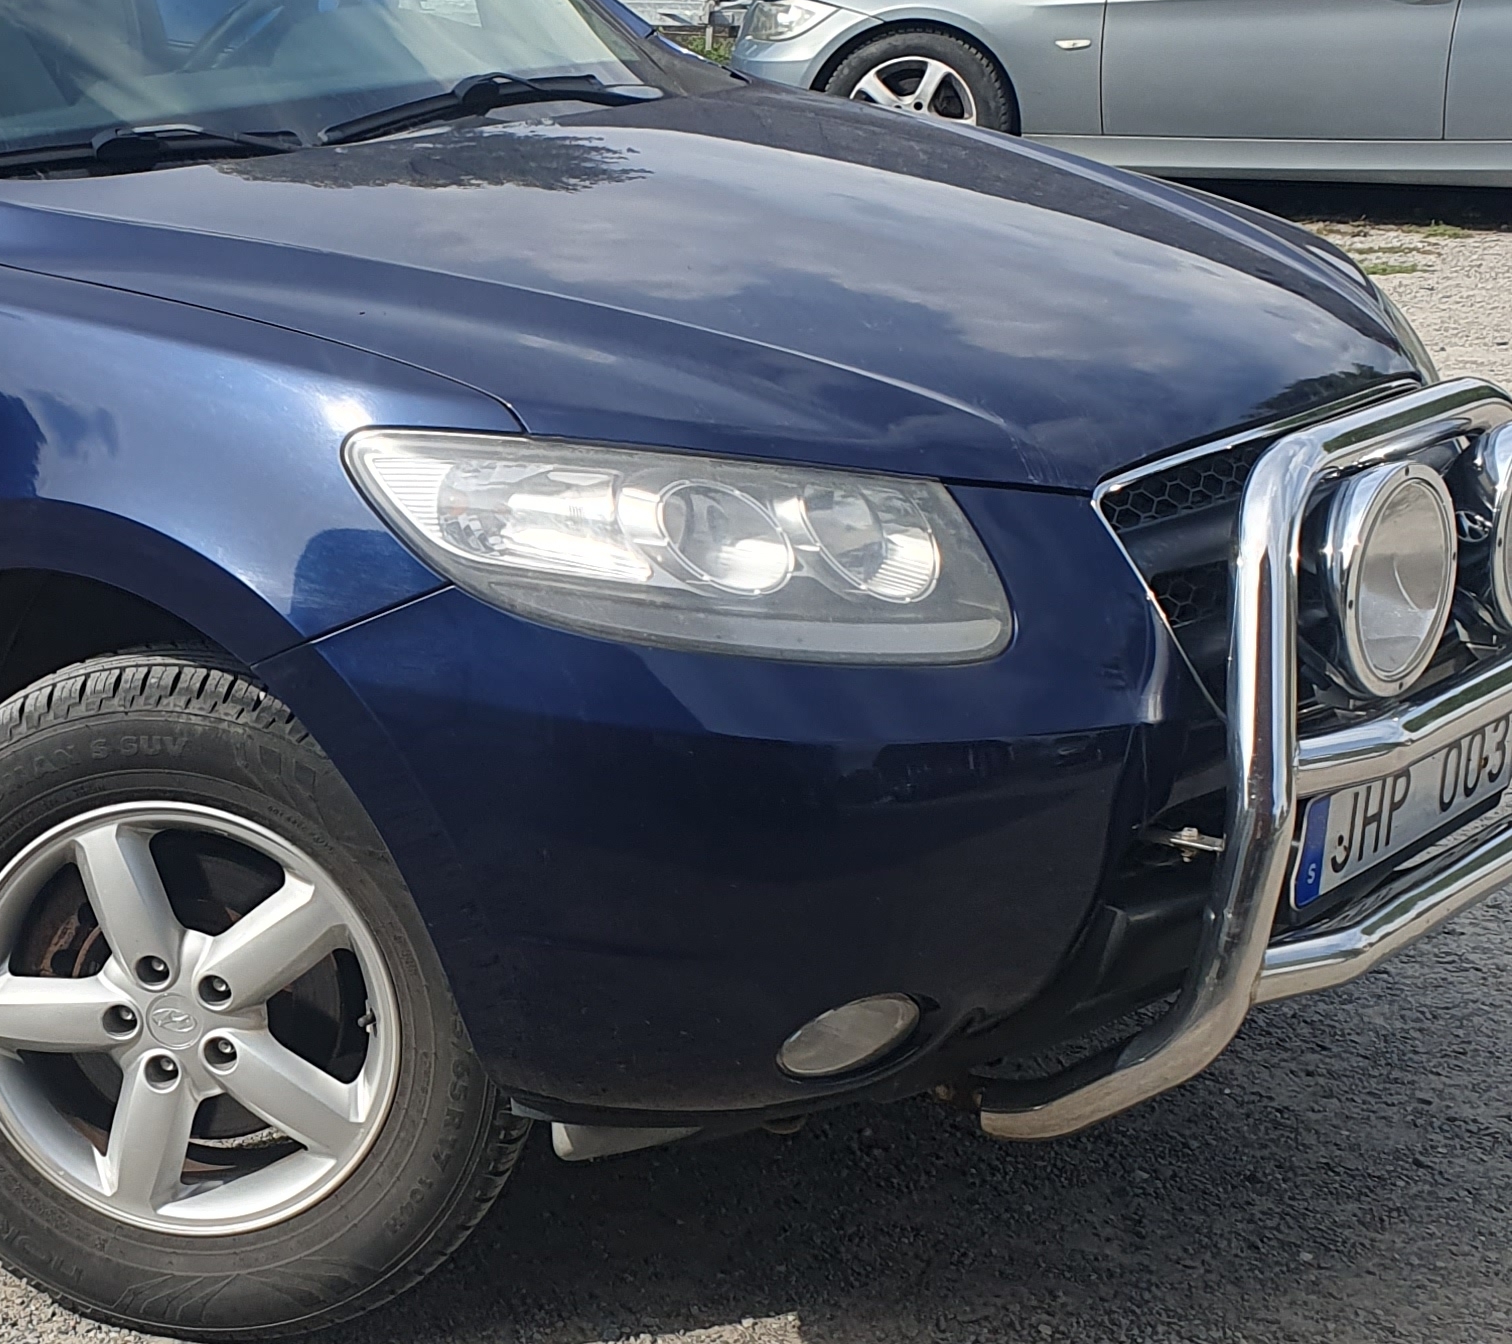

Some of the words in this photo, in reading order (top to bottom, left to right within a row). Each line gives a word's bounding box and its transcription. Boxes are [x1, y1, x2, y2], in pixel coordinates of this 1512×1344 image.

[119, 734, 189, 756] SUV
[1330, 767, 1411, 873] JHP
[1439, 713, 1509, 812] 003
[1307, 863, 1316, 884] S
